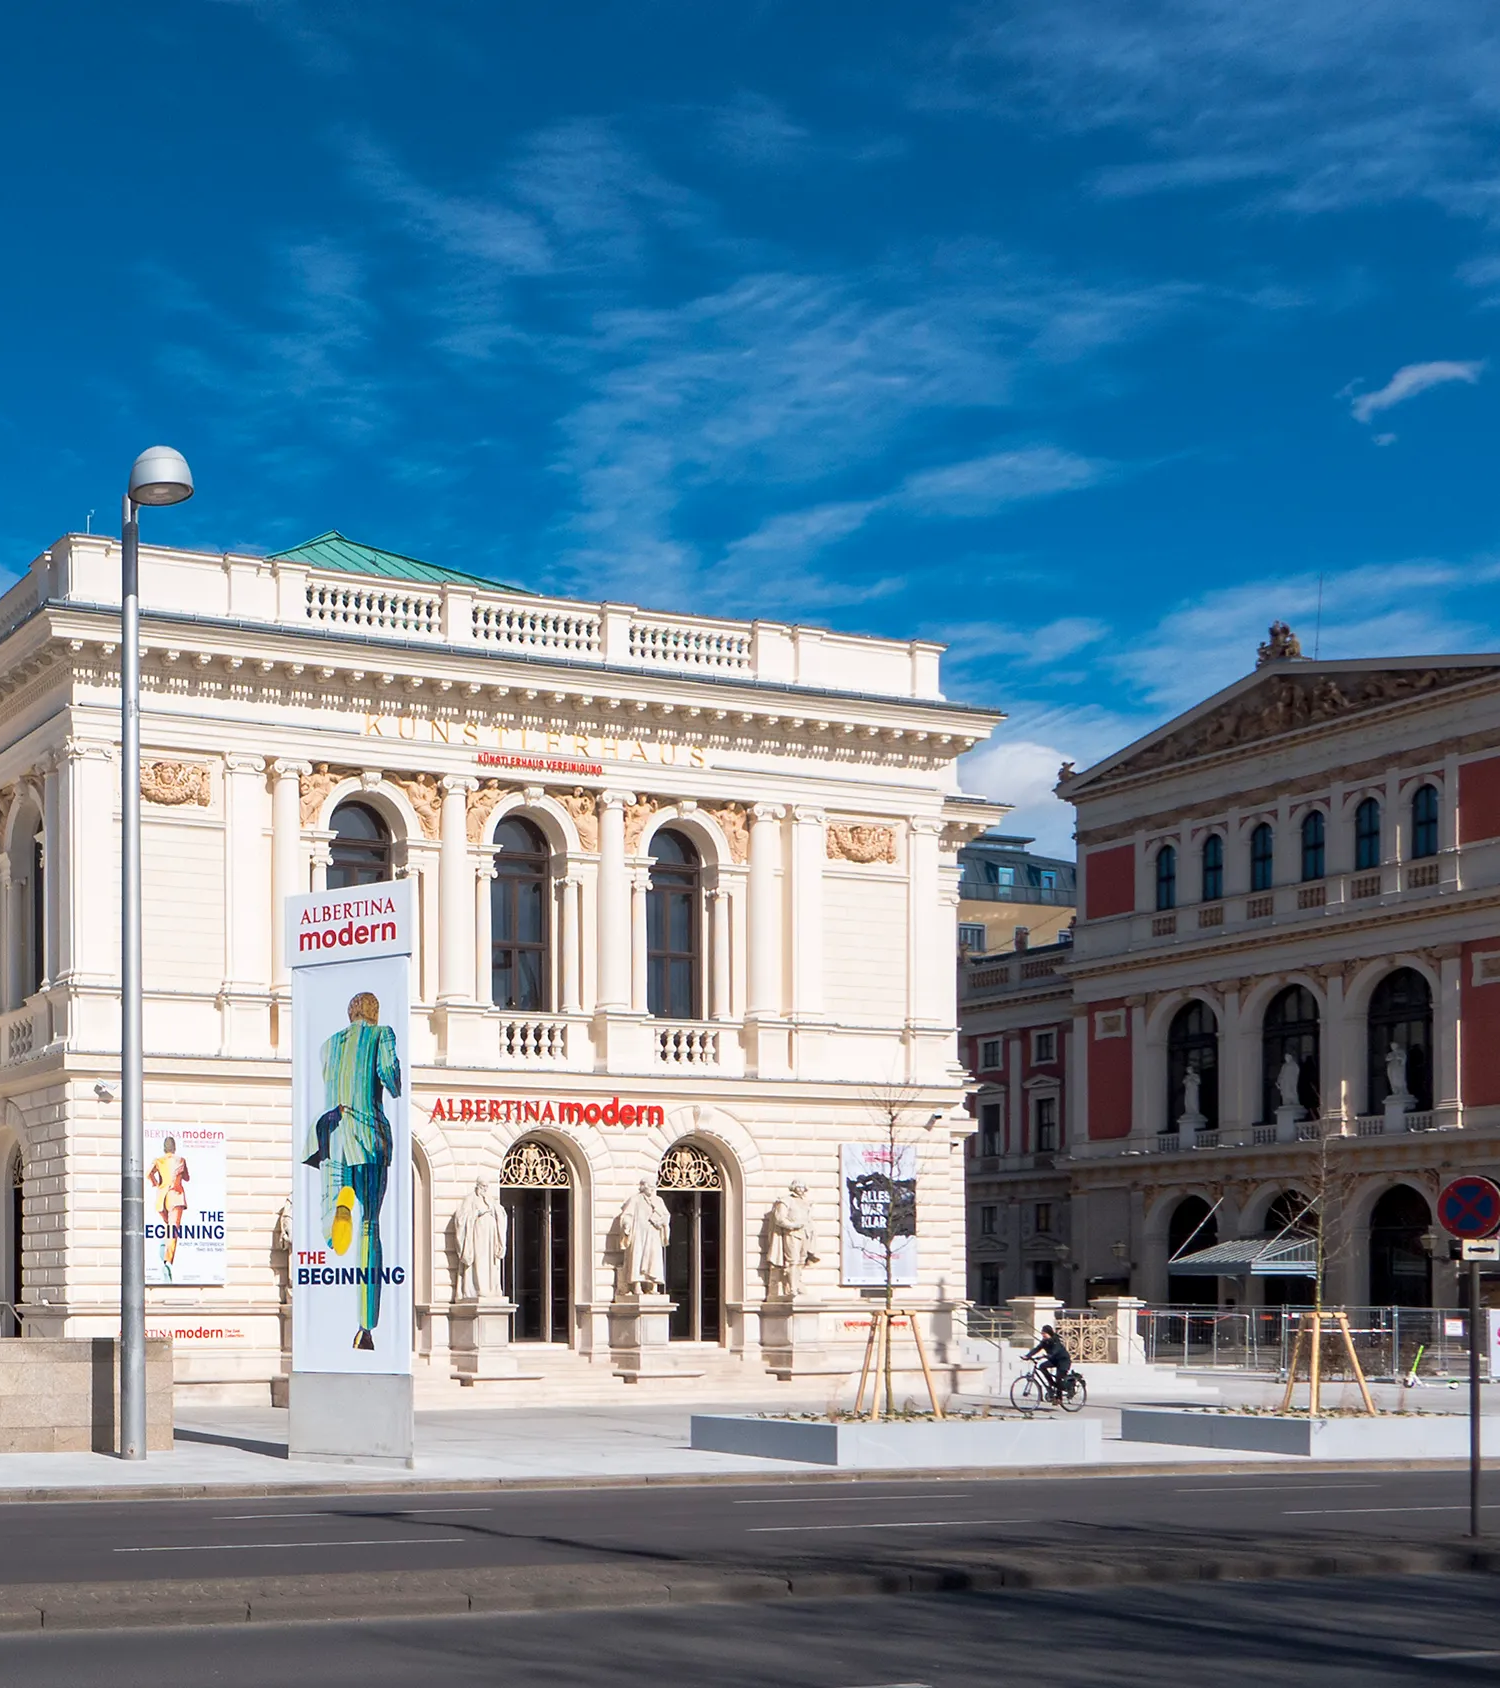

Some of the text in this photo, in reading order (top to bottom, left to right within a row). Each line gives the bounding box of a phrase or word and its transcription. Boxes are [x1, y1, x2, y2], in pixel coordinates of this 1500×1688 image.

[300, 897, 396, 925] ALBERTINA
[299, 921, 397, 951] modern
[429, 1097, 664, 1126] ALBERTINA modern
[144, 1129, 224, 1139] BERTINA modern
[861, 1190, 890, 1203] ALLES
[200, 1211, 224, 1222] THE
[861, 1216, 887, 1228] KLAR
[145, 1225, 225, 1239] EGINNING
[297, 1251, 326, 1264] THE
[298, 1266, 405, 1285] BEGINNING
[175, 1327, 223, 1338] modern
